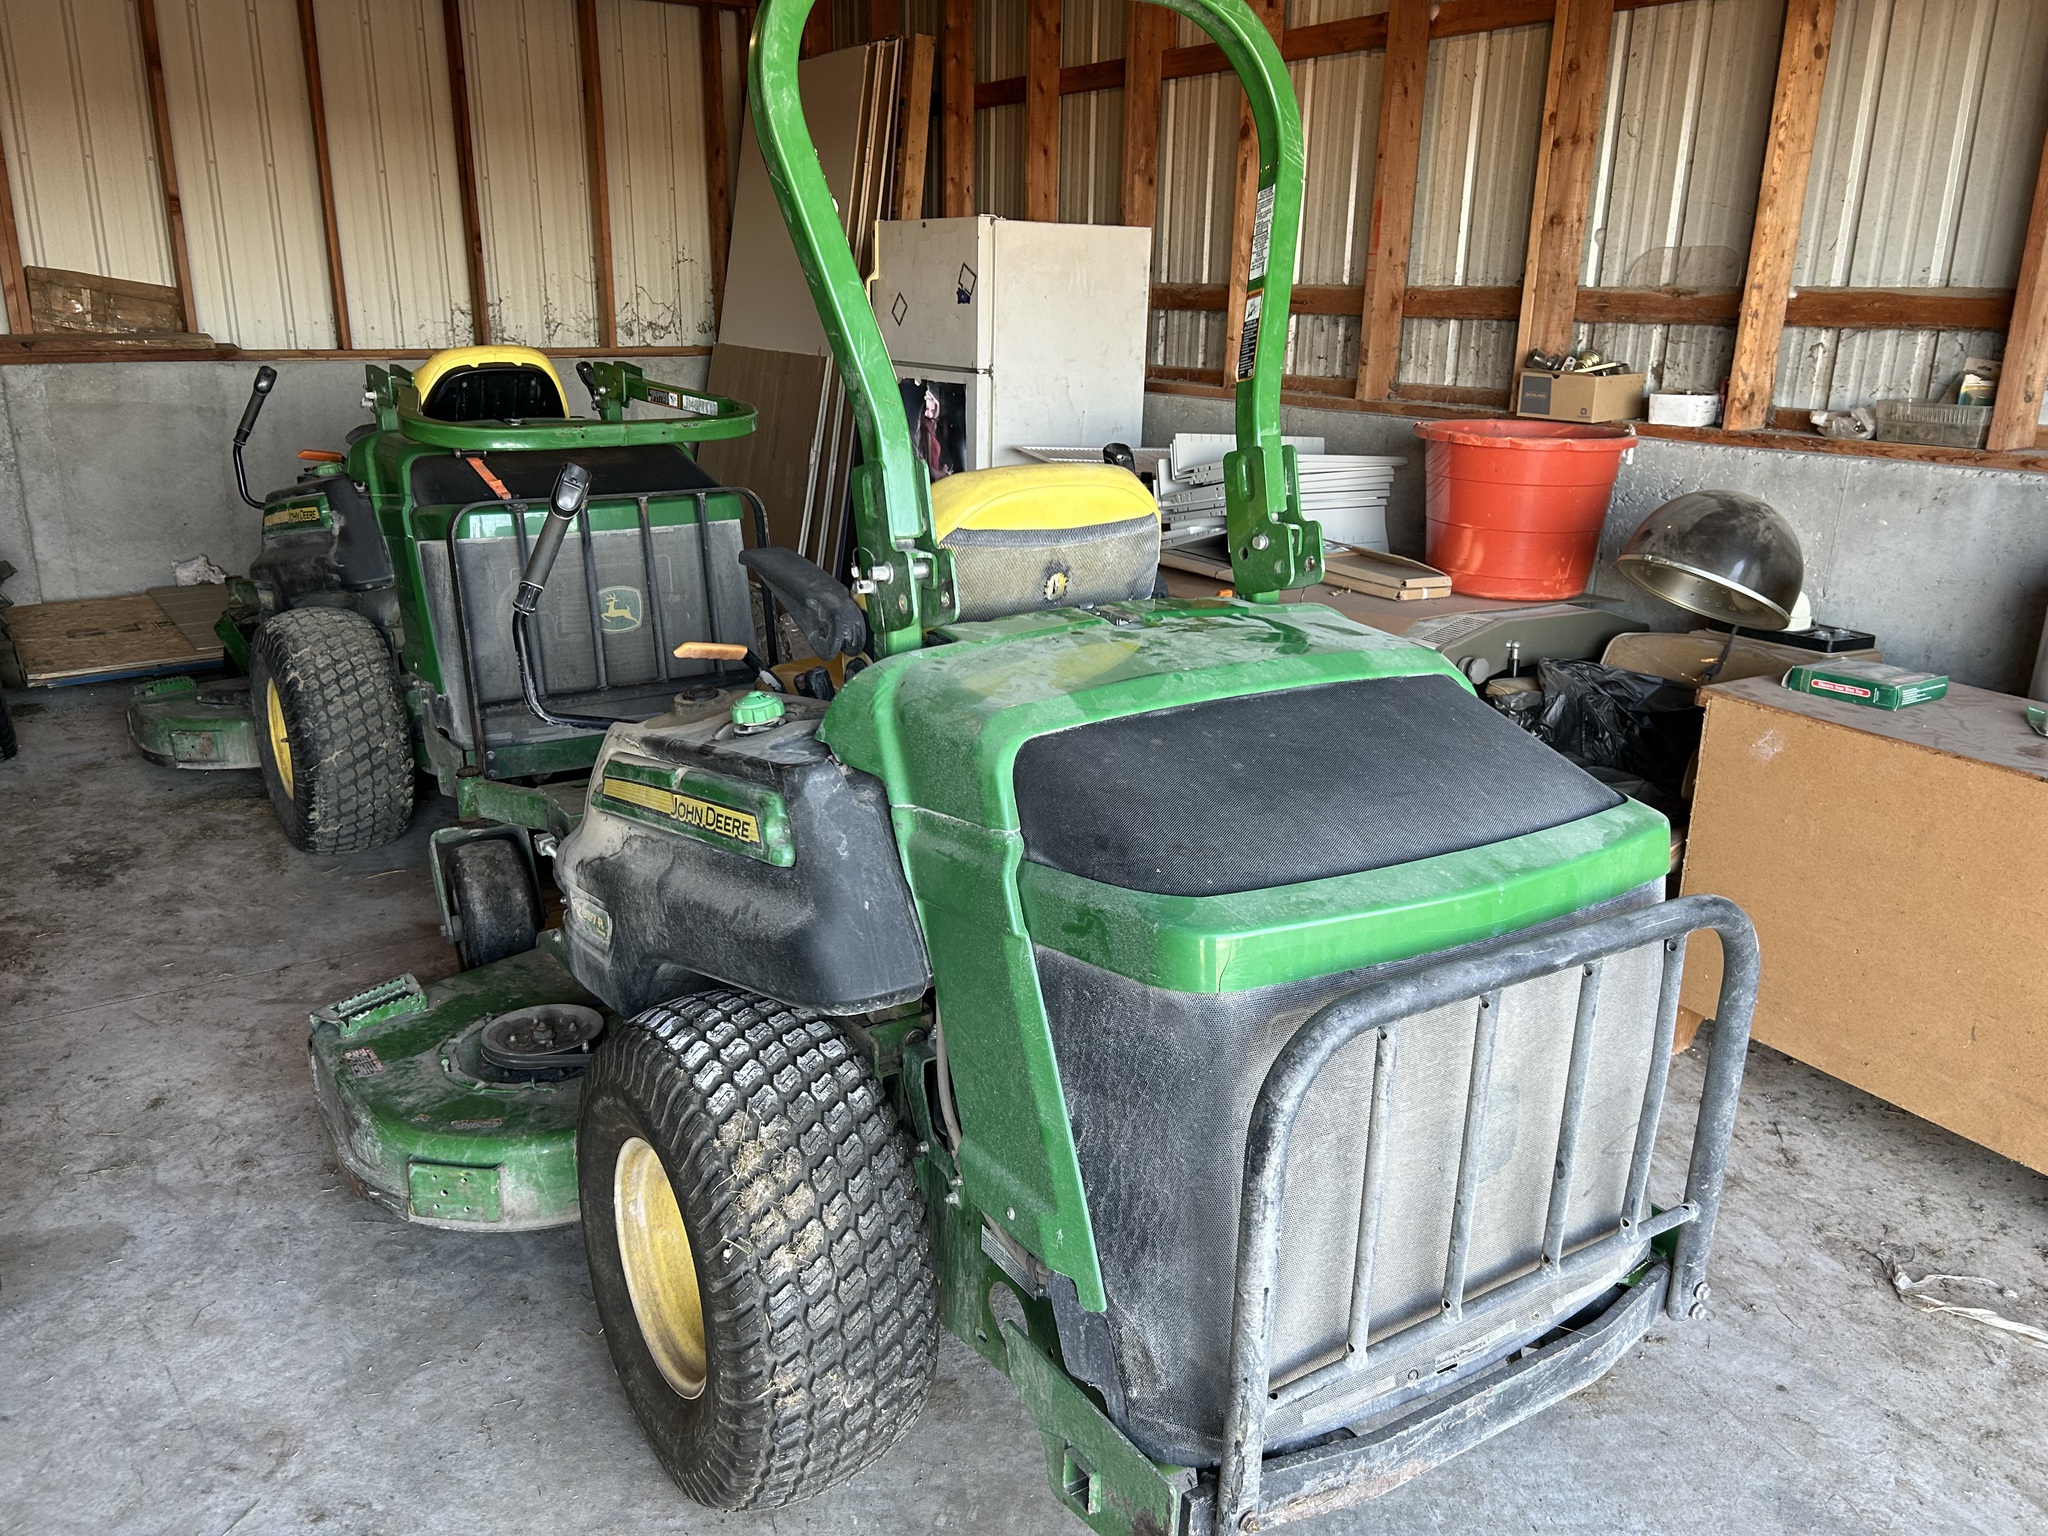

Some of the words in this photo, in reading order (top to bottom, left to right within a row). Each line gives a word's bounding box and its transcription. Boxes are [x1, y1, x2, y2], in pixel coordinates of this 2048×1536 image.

[300, 509, 316, 520] DEERE
[671, 797, 703, 824] JOHN
[705, 806, 751, 839] DEERE
